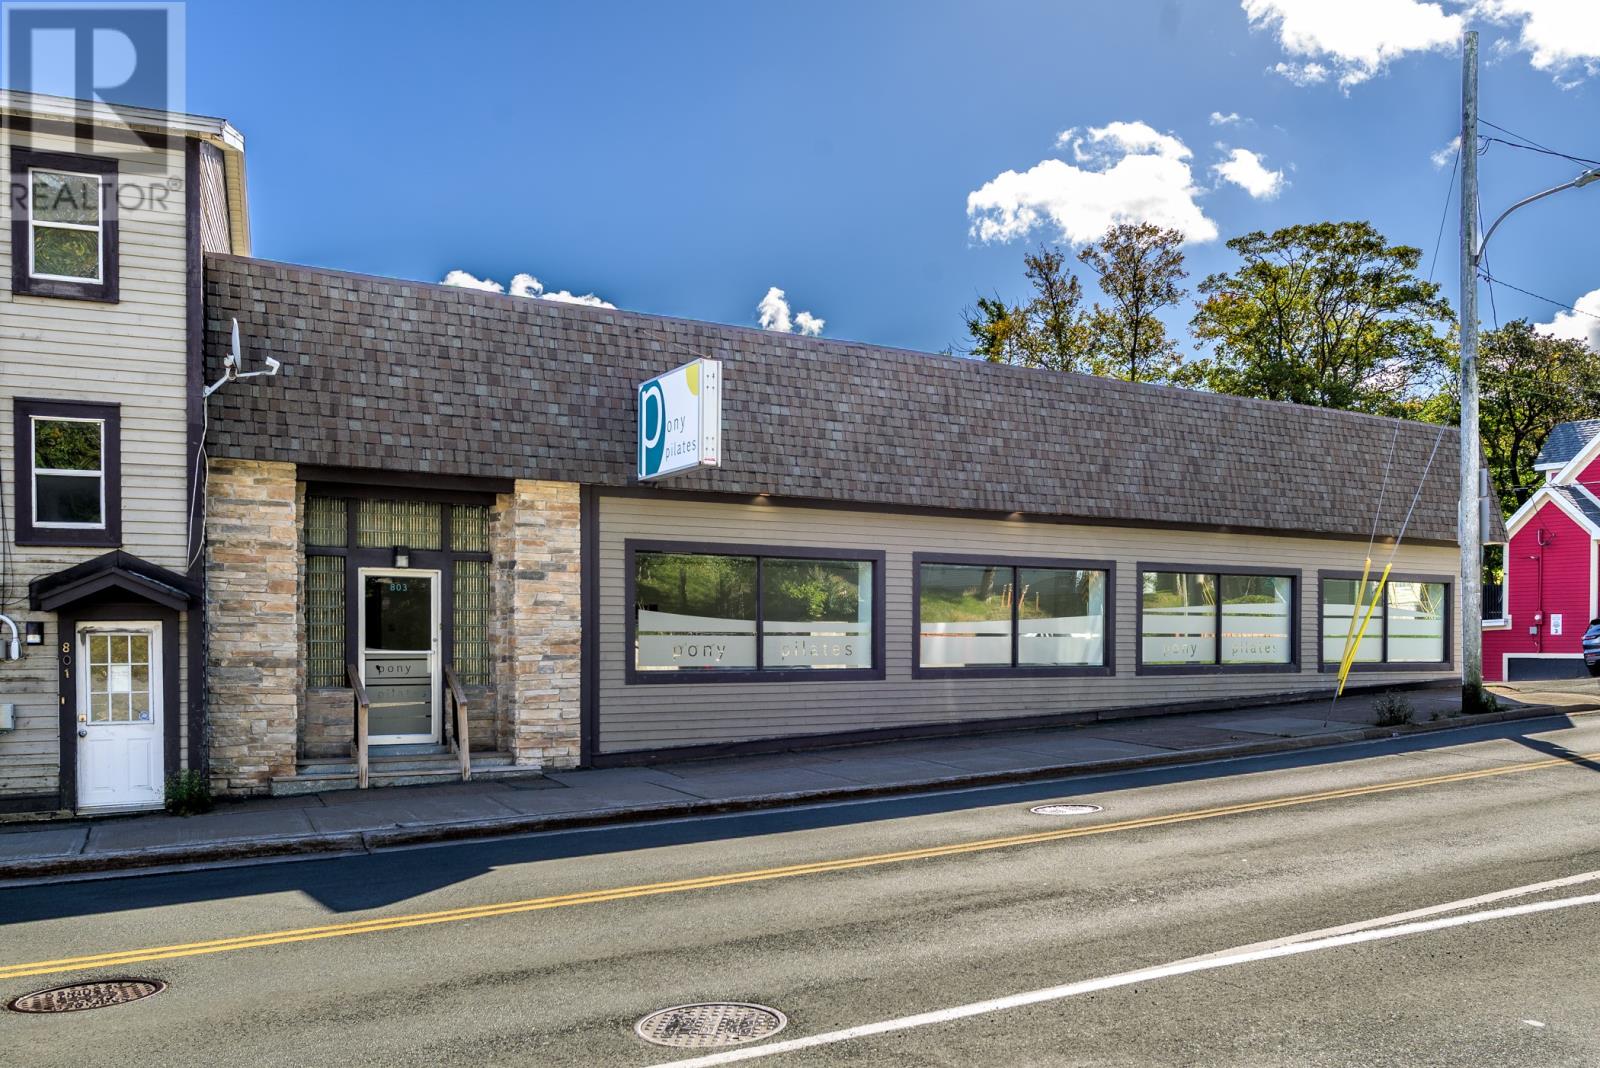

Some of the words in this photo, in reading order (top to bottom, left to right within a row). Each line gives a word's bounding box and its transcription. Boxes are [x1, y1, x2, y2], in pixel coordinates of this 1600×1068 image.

[665, 439, 697, 462] pilates
[390, 583, 408, 592] 803
[673, 644, 726, 662] pony
[781, 640, 853, 662] pilates
[376, 664, 411, 676] pony
